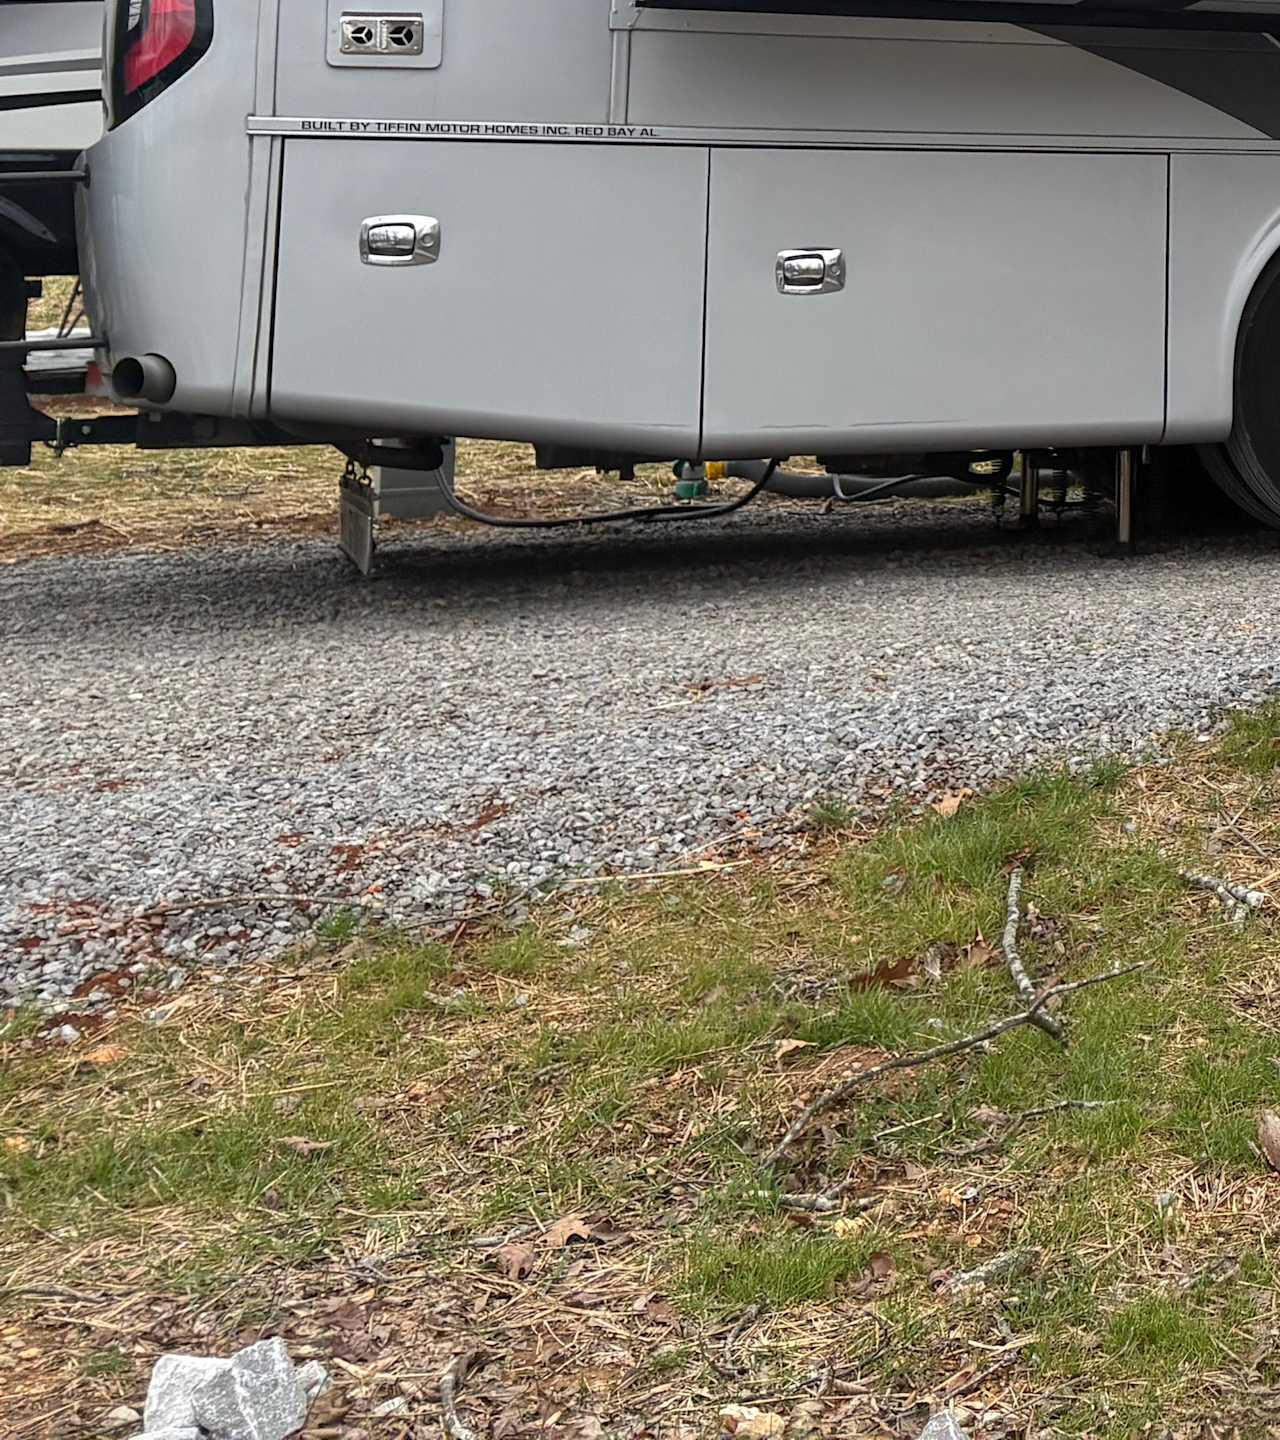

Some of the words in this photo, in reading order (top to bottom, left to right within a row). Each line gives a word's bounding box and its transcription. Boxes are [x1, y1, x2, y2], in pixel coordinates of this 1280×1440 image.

[301, 120, 345, 130] BUILT
[350, 121, 370, 131] BY
[375, 121, 422, 132] TIFFIN
[425, 123, 481, 133] MOTOR
[484, 124, 539, 135] HOMES
[574, 126, 605, 137] RED
[607, 127, 637, 137] BAY
